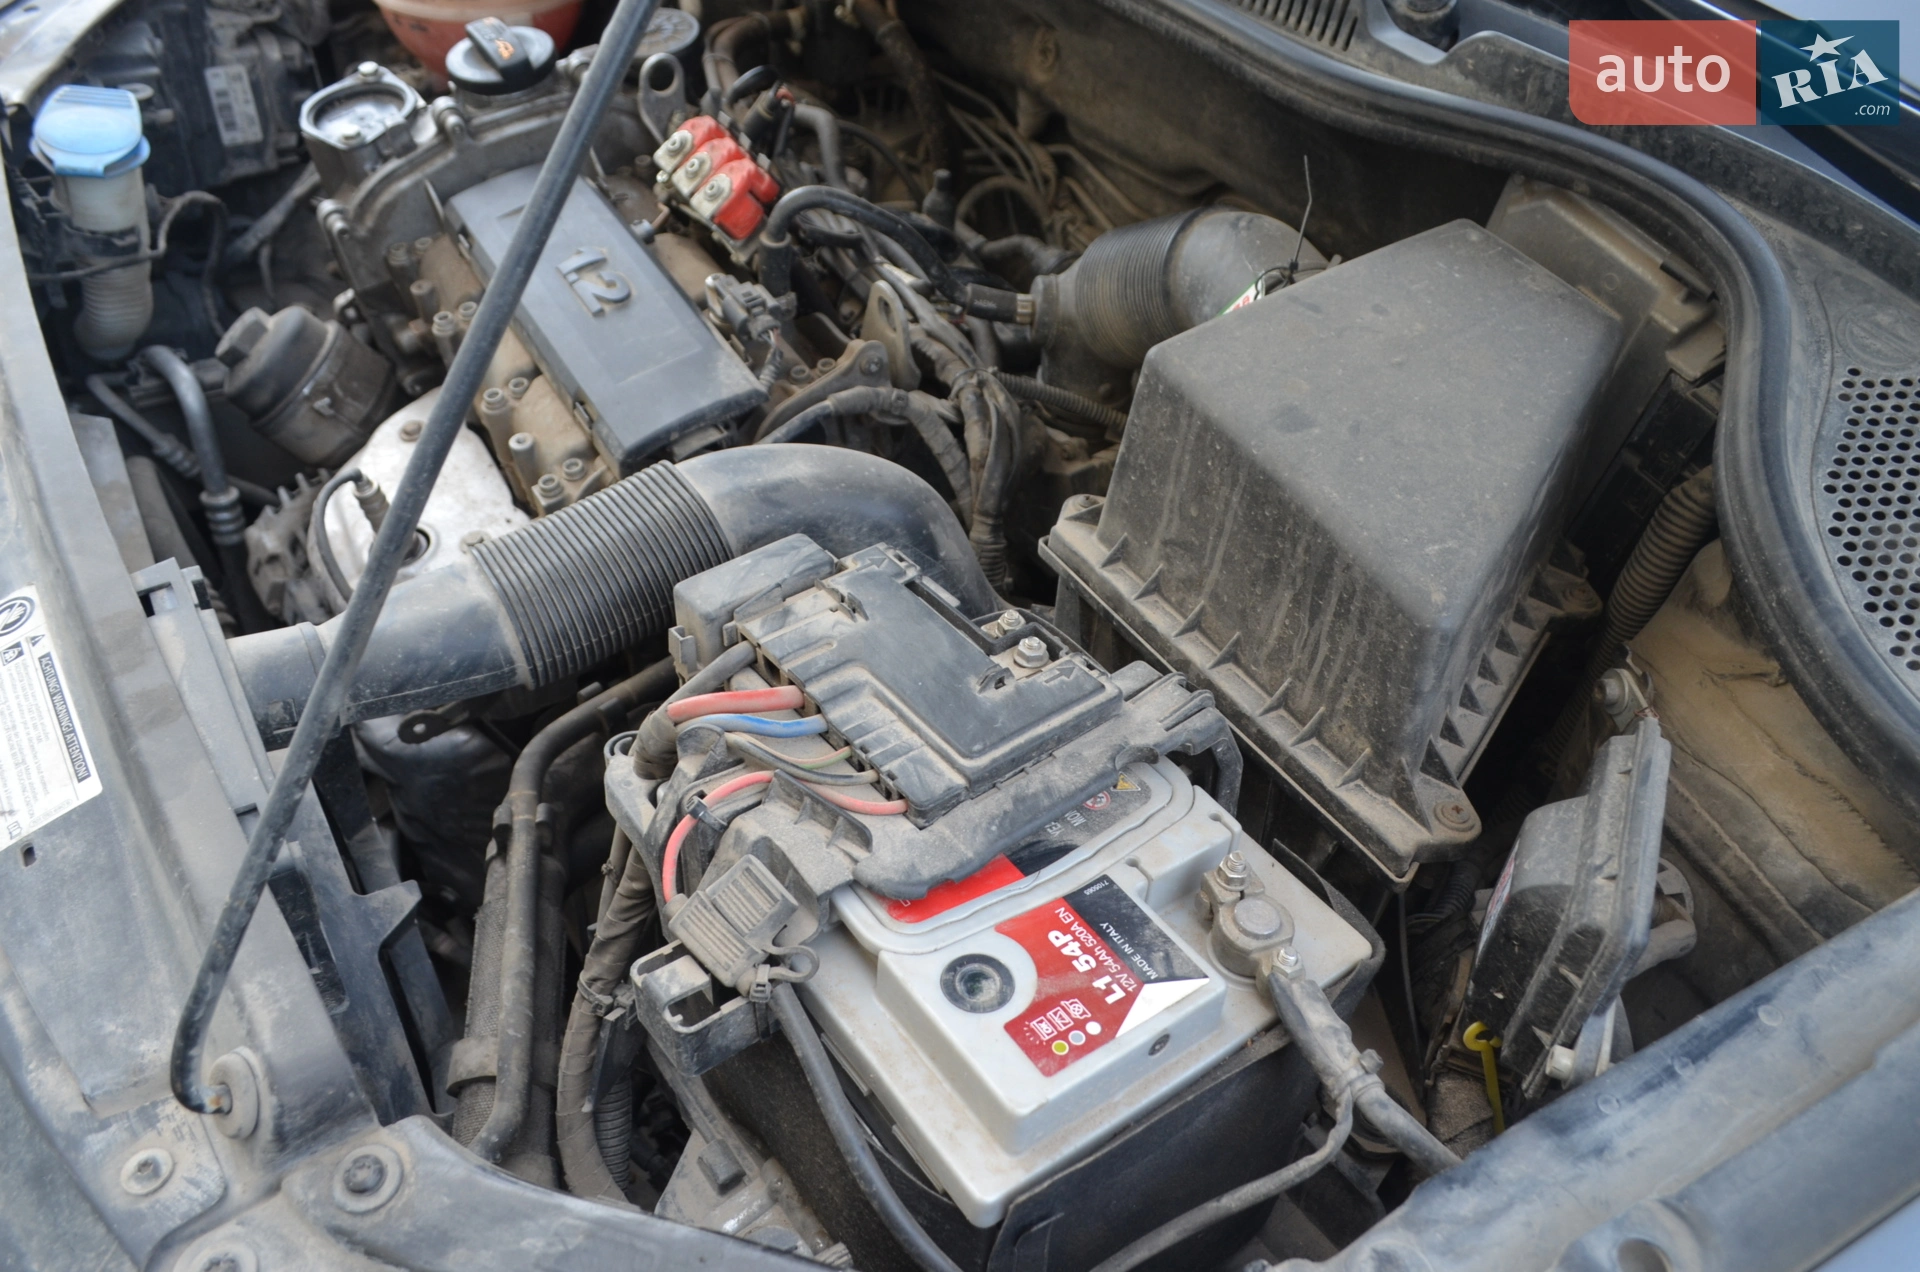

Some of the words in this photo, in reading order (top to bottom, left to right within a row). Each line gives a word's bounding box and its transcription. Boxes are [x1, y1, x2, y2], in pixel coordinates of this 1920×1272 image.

[40, 656, 58, 694] ACHTUNG!
[52, 692, 73, 733] WARNING!
[66, 732, 89, 779] ATTENTION!
[1055, 907, 1074, 923] EN
[1071, 921, 1097, 948] 520A
[1100, 921, 1125, 944] ITALY
[1048, 930, 1098, 973] 54P
[1093, 945, 1120, 974] 54Ah
[1121, 943, 1133, 954] IN
[1131, 953, 1158, 979] MADE
[1093, 975, 1126, 1004] L1
[1115, 973, 1137, 991] 12V
